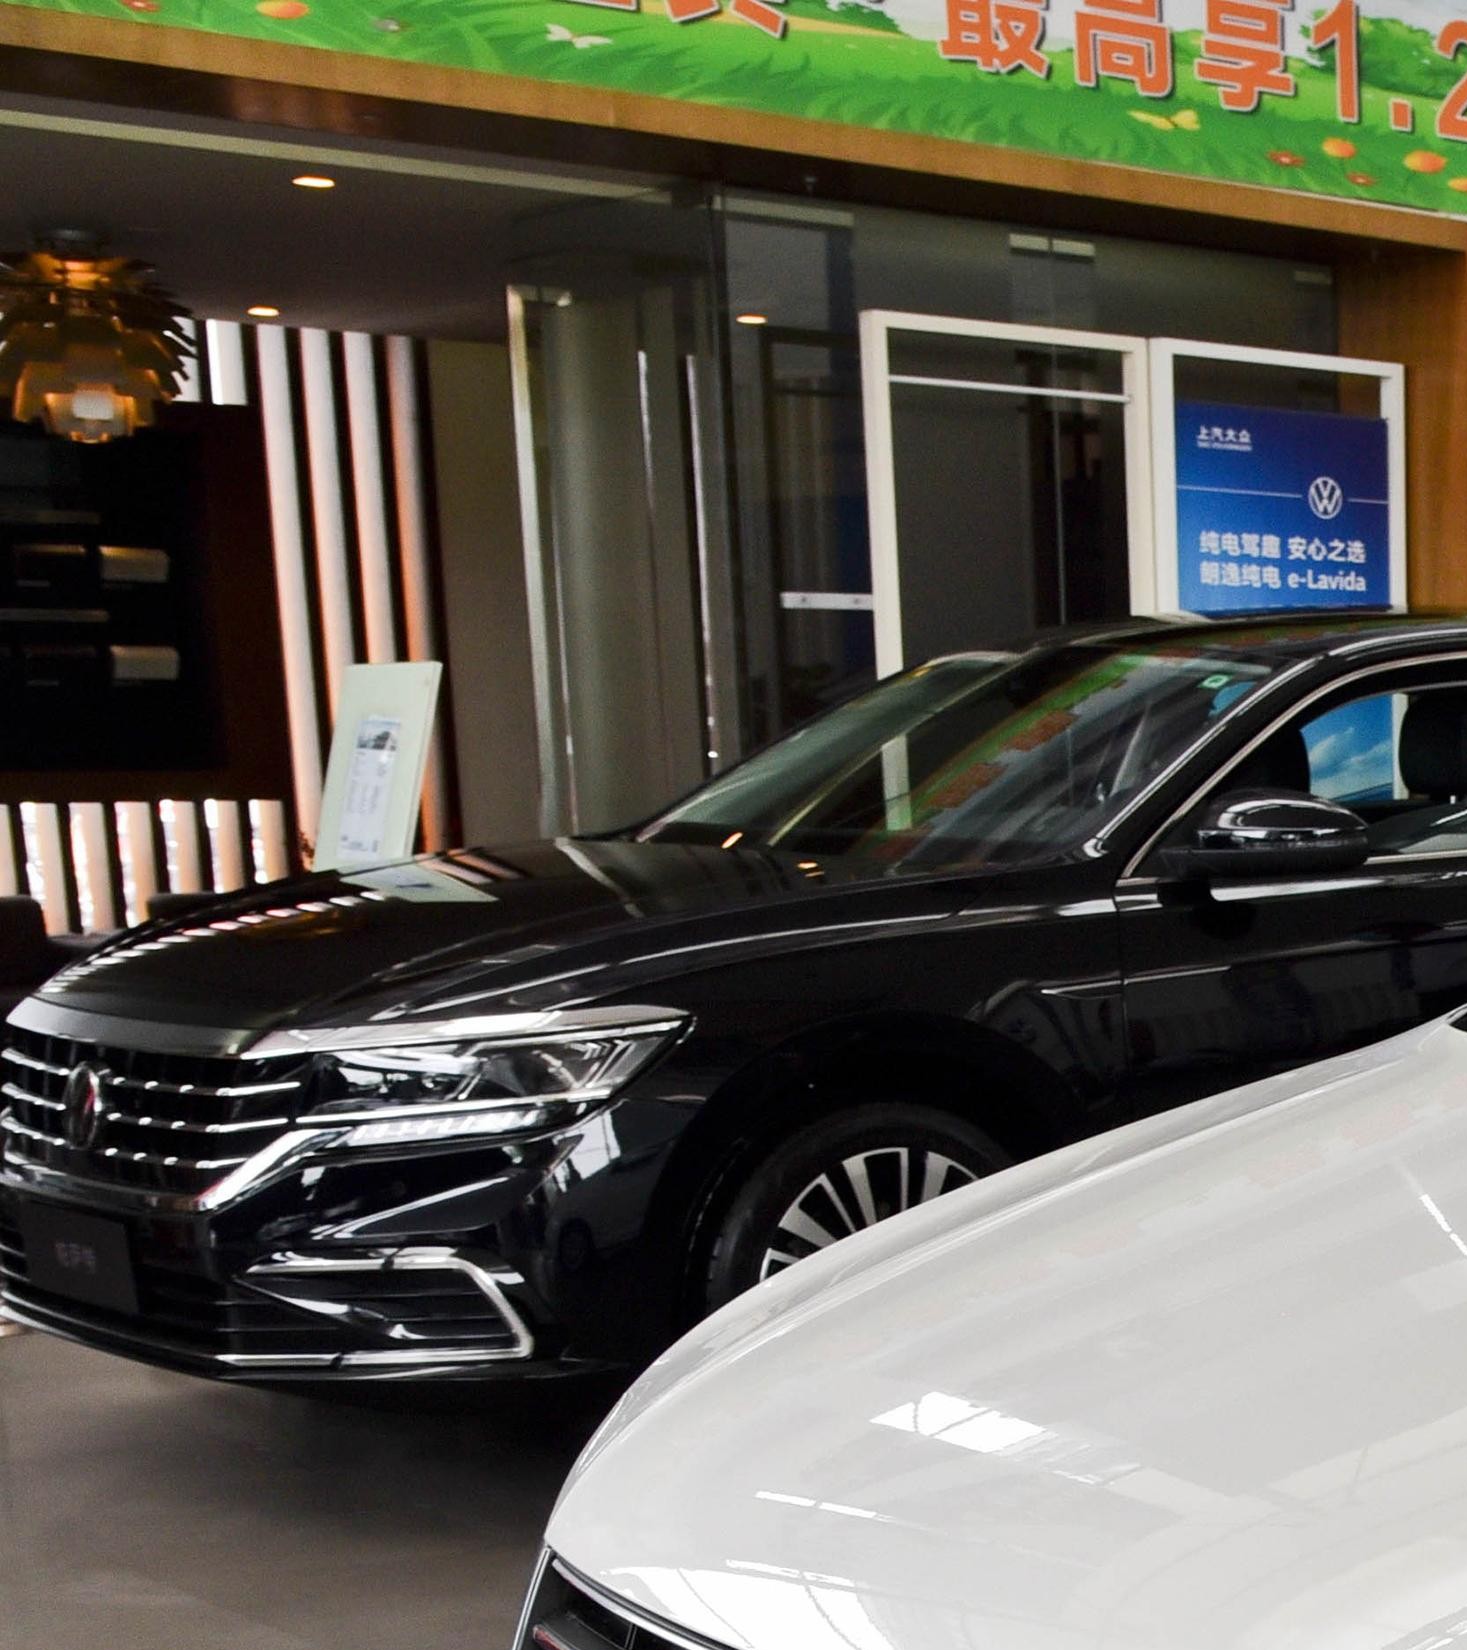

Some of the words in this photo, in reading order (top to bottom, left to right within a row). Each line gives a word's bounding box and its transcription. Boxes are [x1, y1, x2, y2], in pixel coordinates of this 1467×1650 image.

[1200, 530, 1281, 558] 纯电驾趣
[1287, 536, 1366, 564] 安心之选
[1200, 561, 1281, 589] 朗逸纯电
[1287, 569, 1366, 591] e-Lavida
